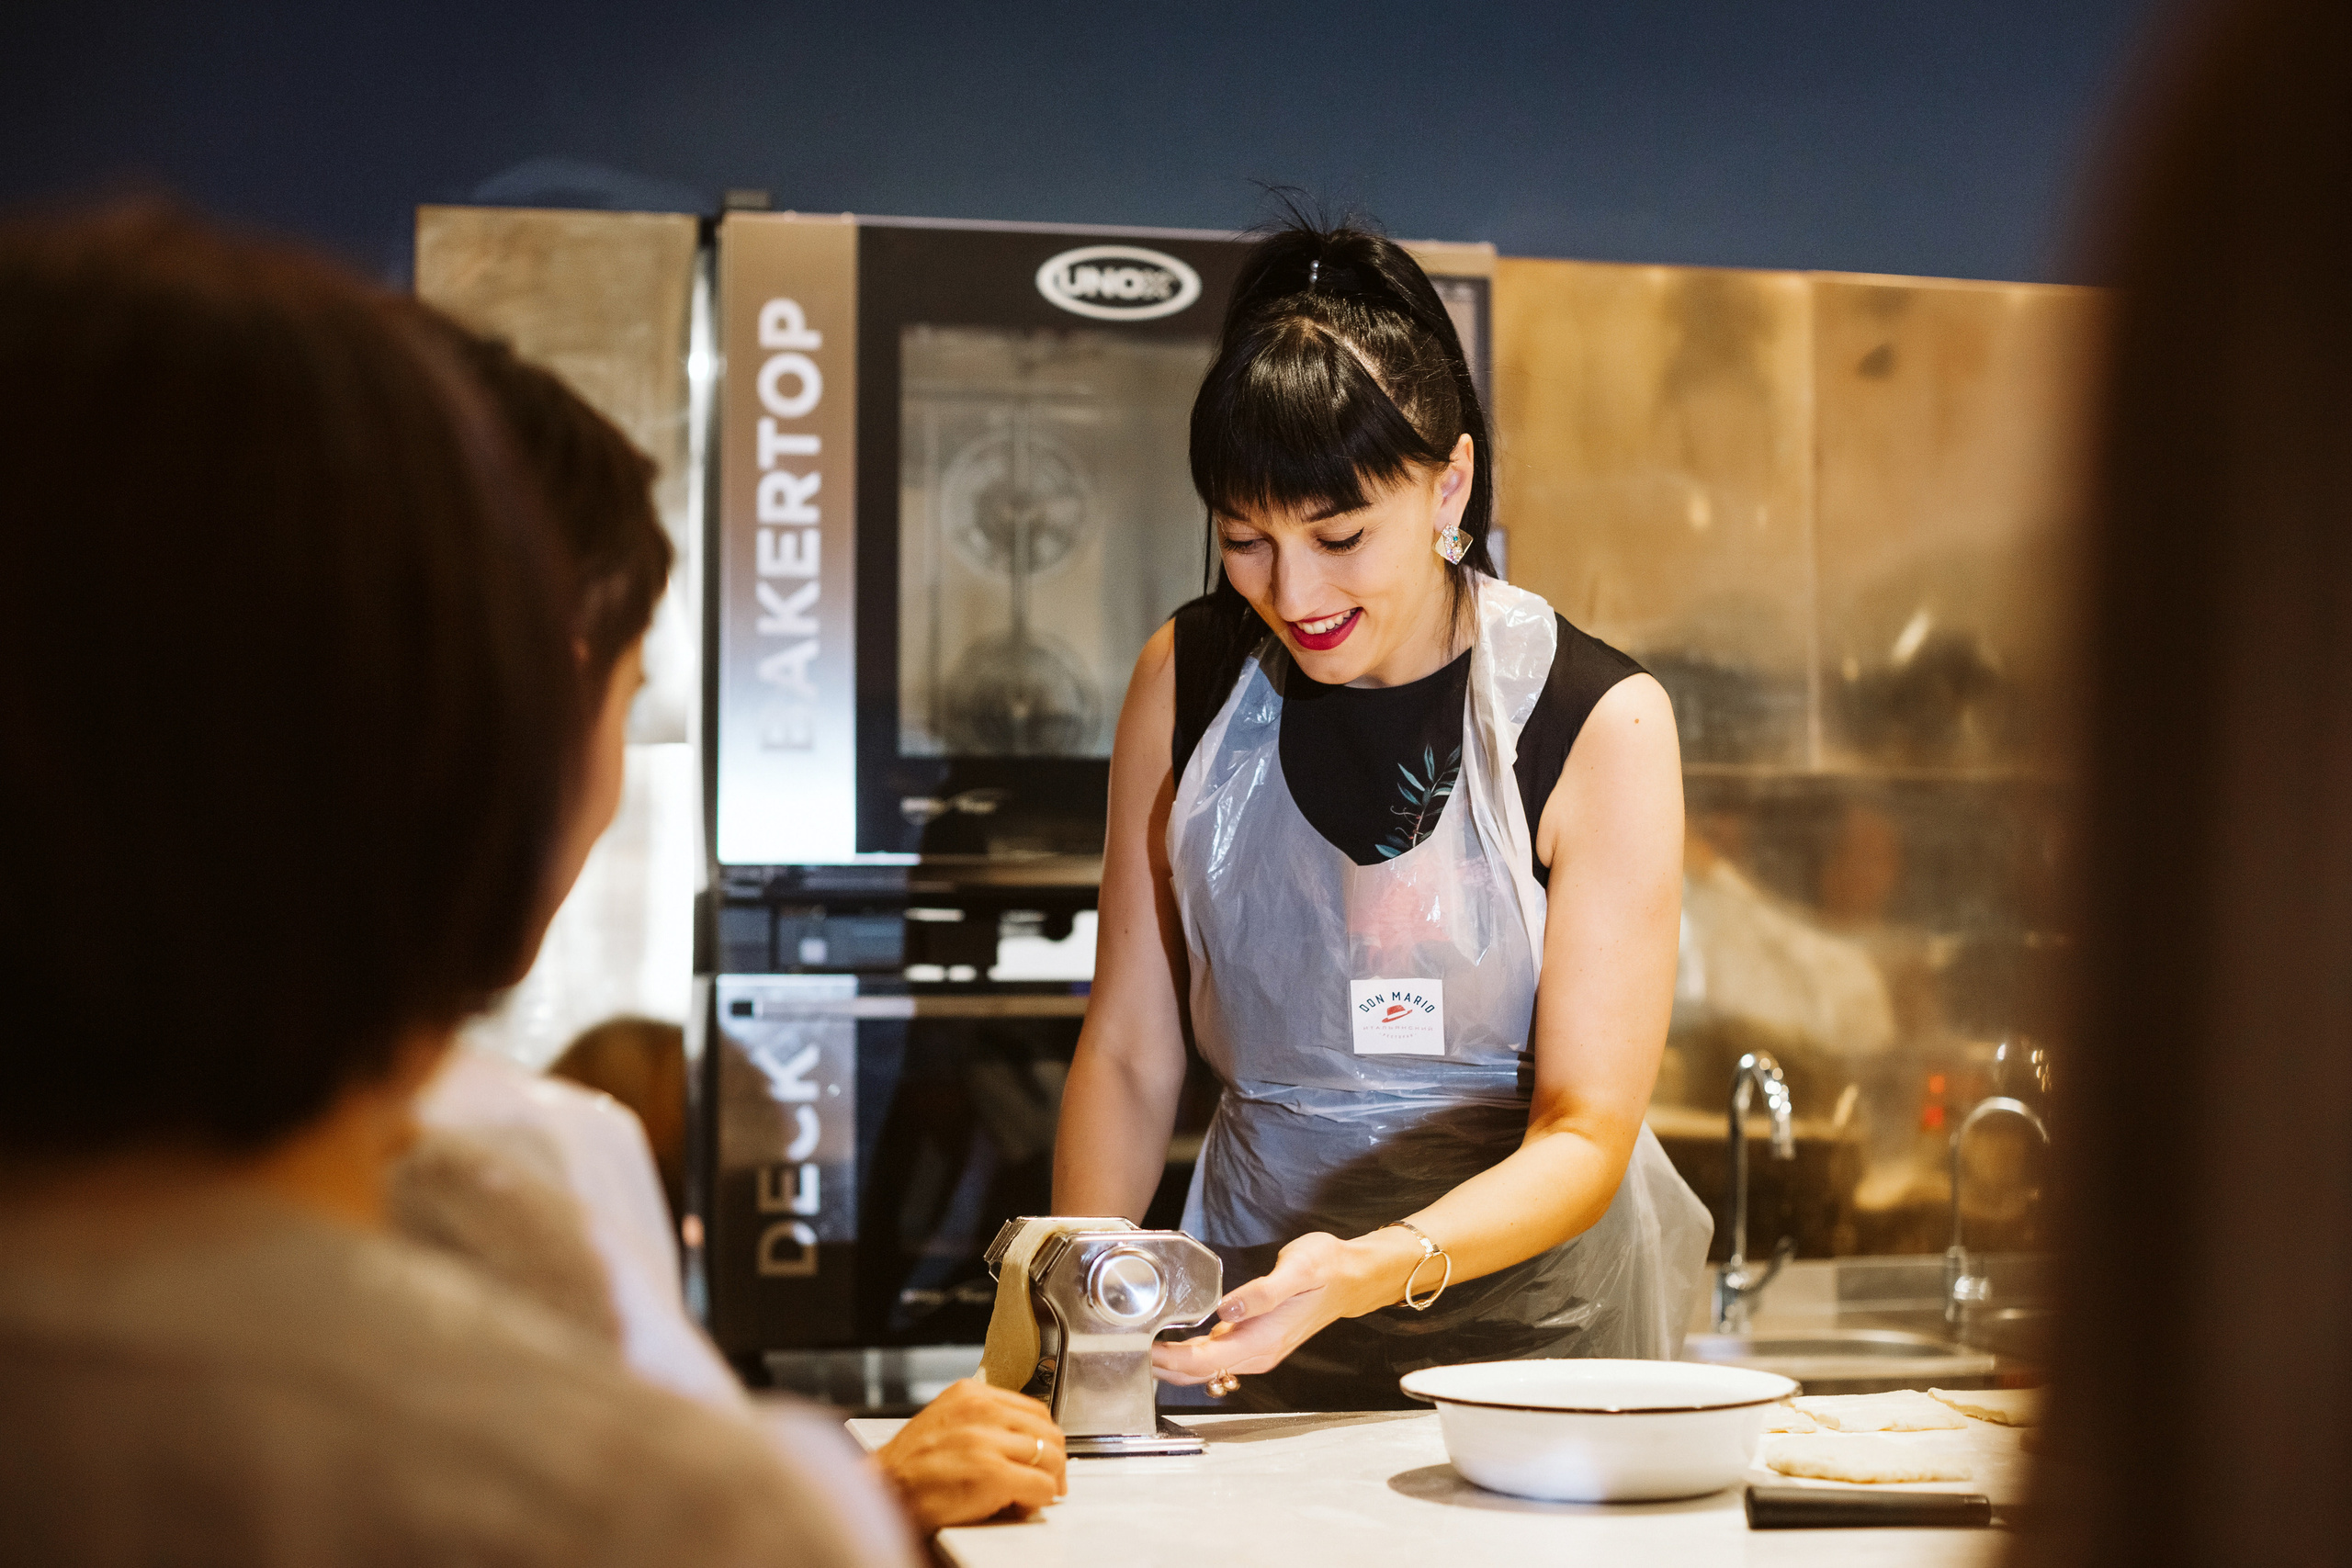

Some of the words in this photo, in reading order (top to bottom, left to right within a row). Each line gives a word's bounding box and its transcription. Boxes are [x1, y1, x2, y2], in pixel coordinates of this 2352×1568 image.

[1359, 994, 1385, 1012] DON
[1392, 991, 1435, 1013] MARIO
[757, 1043, 820, 1276] DECK
